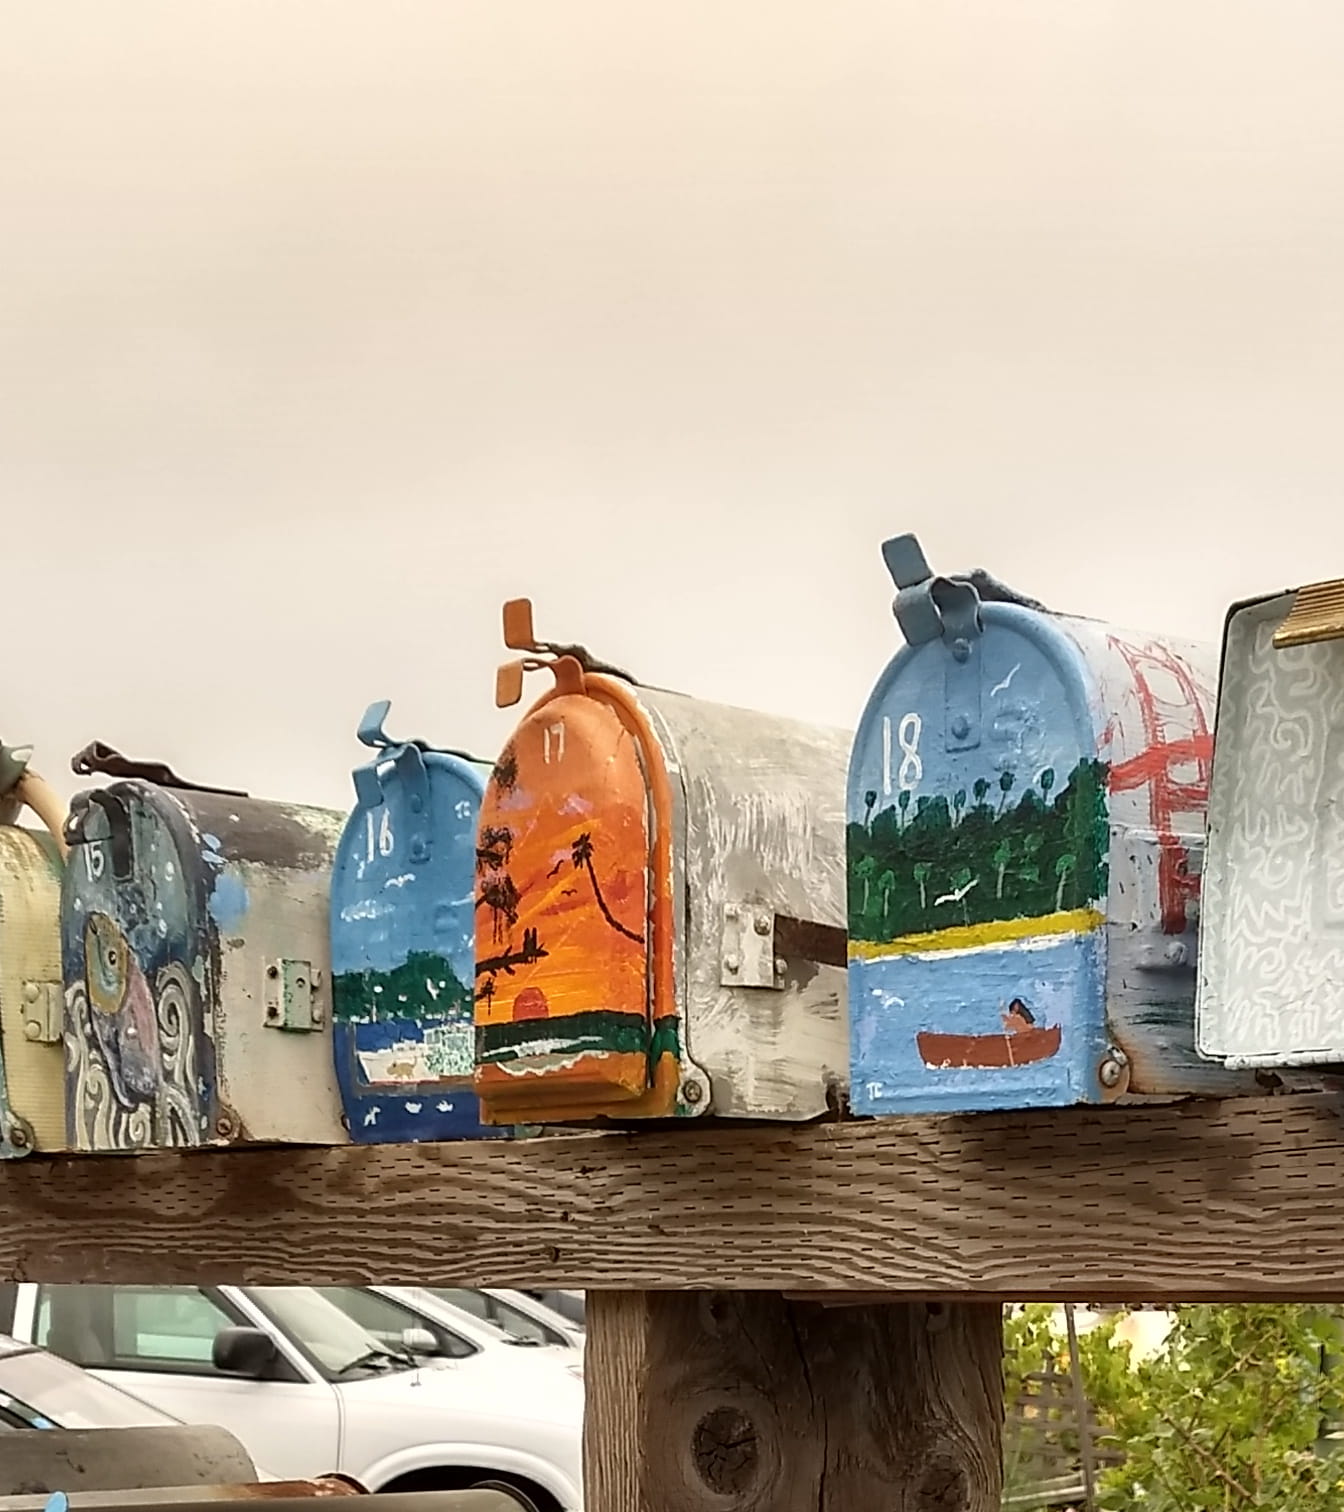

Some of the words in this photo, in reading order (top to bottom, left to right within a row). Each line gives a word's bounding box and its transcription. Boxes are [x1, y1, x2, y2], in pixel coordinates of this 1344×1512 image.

[544, 721, 565, 764] 17
[882, 712, 923, 796] 18
[367, 808, 394, 863] 16
[83, 840, 105, 882] 15
